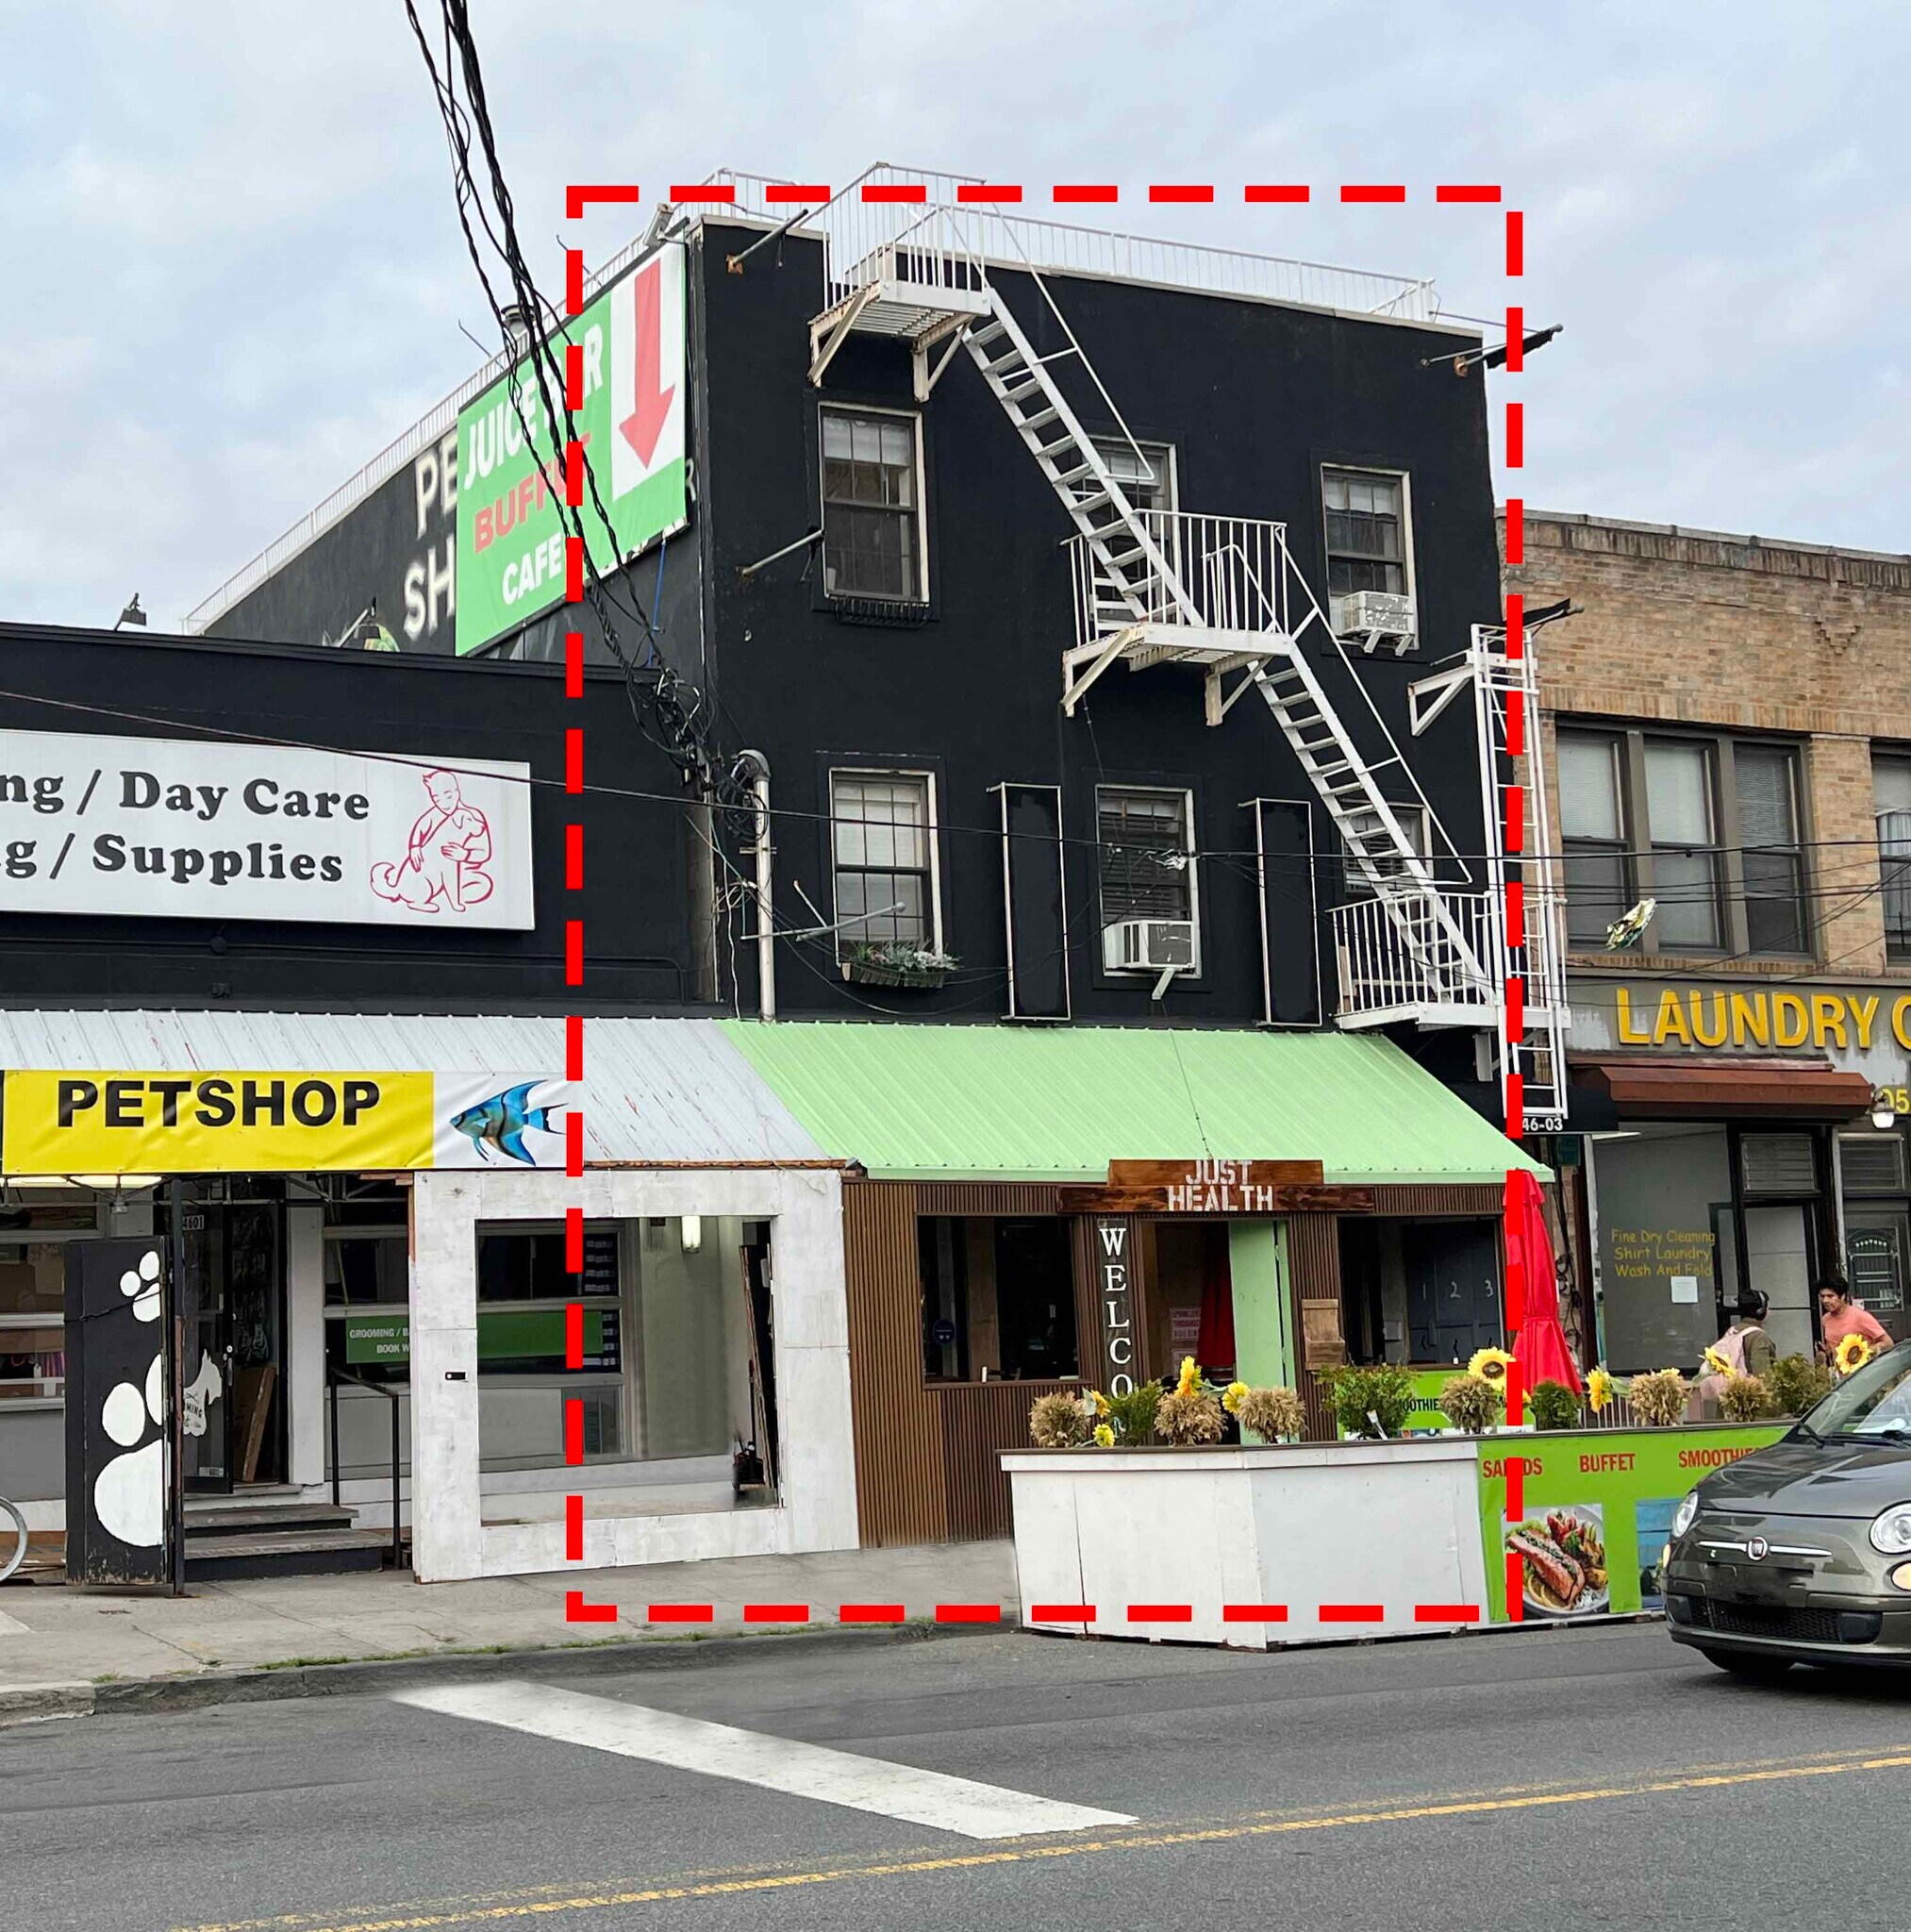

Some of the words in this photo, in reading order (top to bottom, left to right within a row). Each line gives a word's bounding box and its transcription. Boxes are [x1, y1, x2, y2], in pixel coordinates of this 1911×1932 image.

[464, 375, 537, 491] JUICE
[543, 323, 603, 429] BR
[503, 532, 562, 606] CAFE
[119, 770, 229, 821] Day
[242, 778, 370, 820] Care
[92, 833, 343, 886] Supplies
[1616, 987, 1880, 1050] LAUNDRY
[58, 1080, 380, 1127] PETSHOP
[1522, 1117, 1564, 1131] 46-03
[1186, 1159, 1253, 1185] JUST
[1169, 1185, 1273, 1211] HEALTH
[1611, 1228, 1637, 1243] Fine
[1641, 1229, 1663, 1244] Dry
[1666, 1230, 1716, 1246] Cleaning
[1614, 1246, 1651, 1260] Shirt
[1656, 1246, 1711, 1261] Laundry
[1615, 1264, 1651, 1277] Wash
[1656, 1264, 1680, 1276] And
[1685, 1263, 1713, 1277] Fold
[1450, 1281, 1461, 1298] 2
[1485, 1279, 1494, 1297] 3
[349, 1328, 394, 1339] GROOMING
[376, 1344, 400, 1354] BOOK
[1483, 1457, 1543, 1478] SADS
[1579, 1453, 1636, 1473] BUFFET
